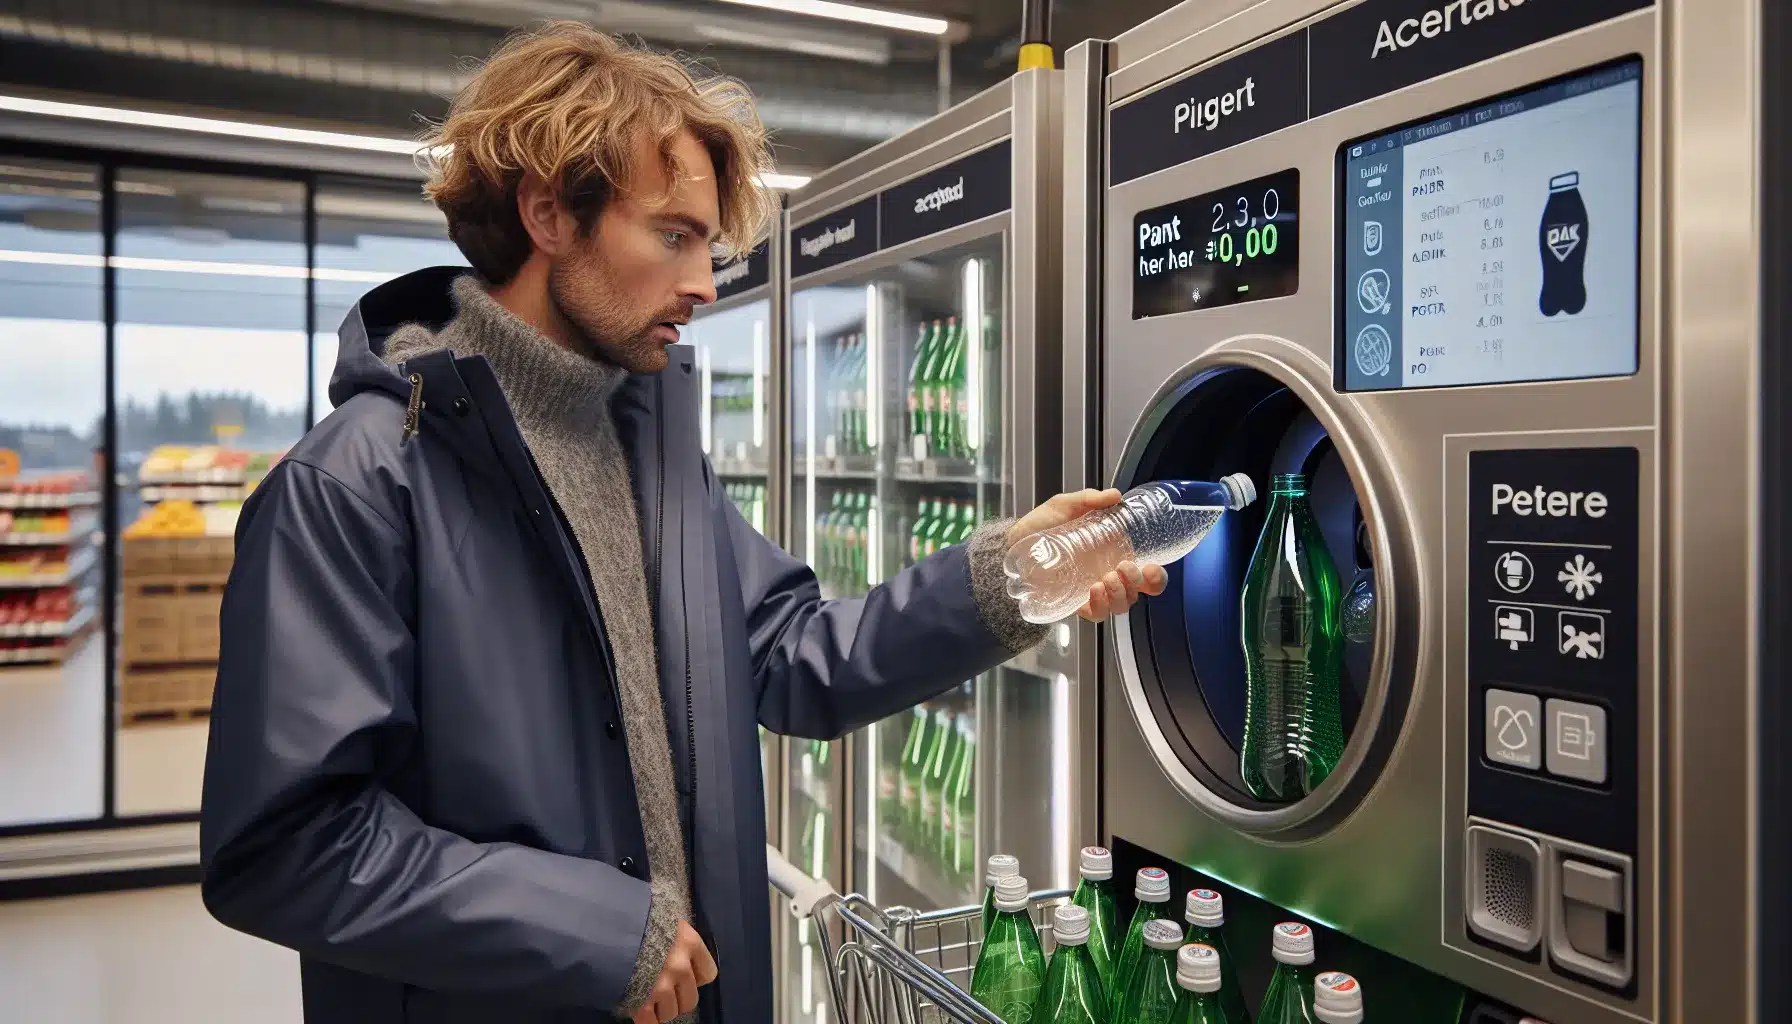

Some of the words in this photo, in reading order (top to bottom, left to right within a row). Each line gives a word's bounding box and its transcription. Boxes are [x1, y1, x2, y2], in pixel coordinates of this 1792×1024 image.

[1371, 0, 1526, 58] Acerta
[1139, 215, 1181, 249] Pant
[1140, 255, 1165, 276] her
[1492, 483, 1608, 518] Petere
